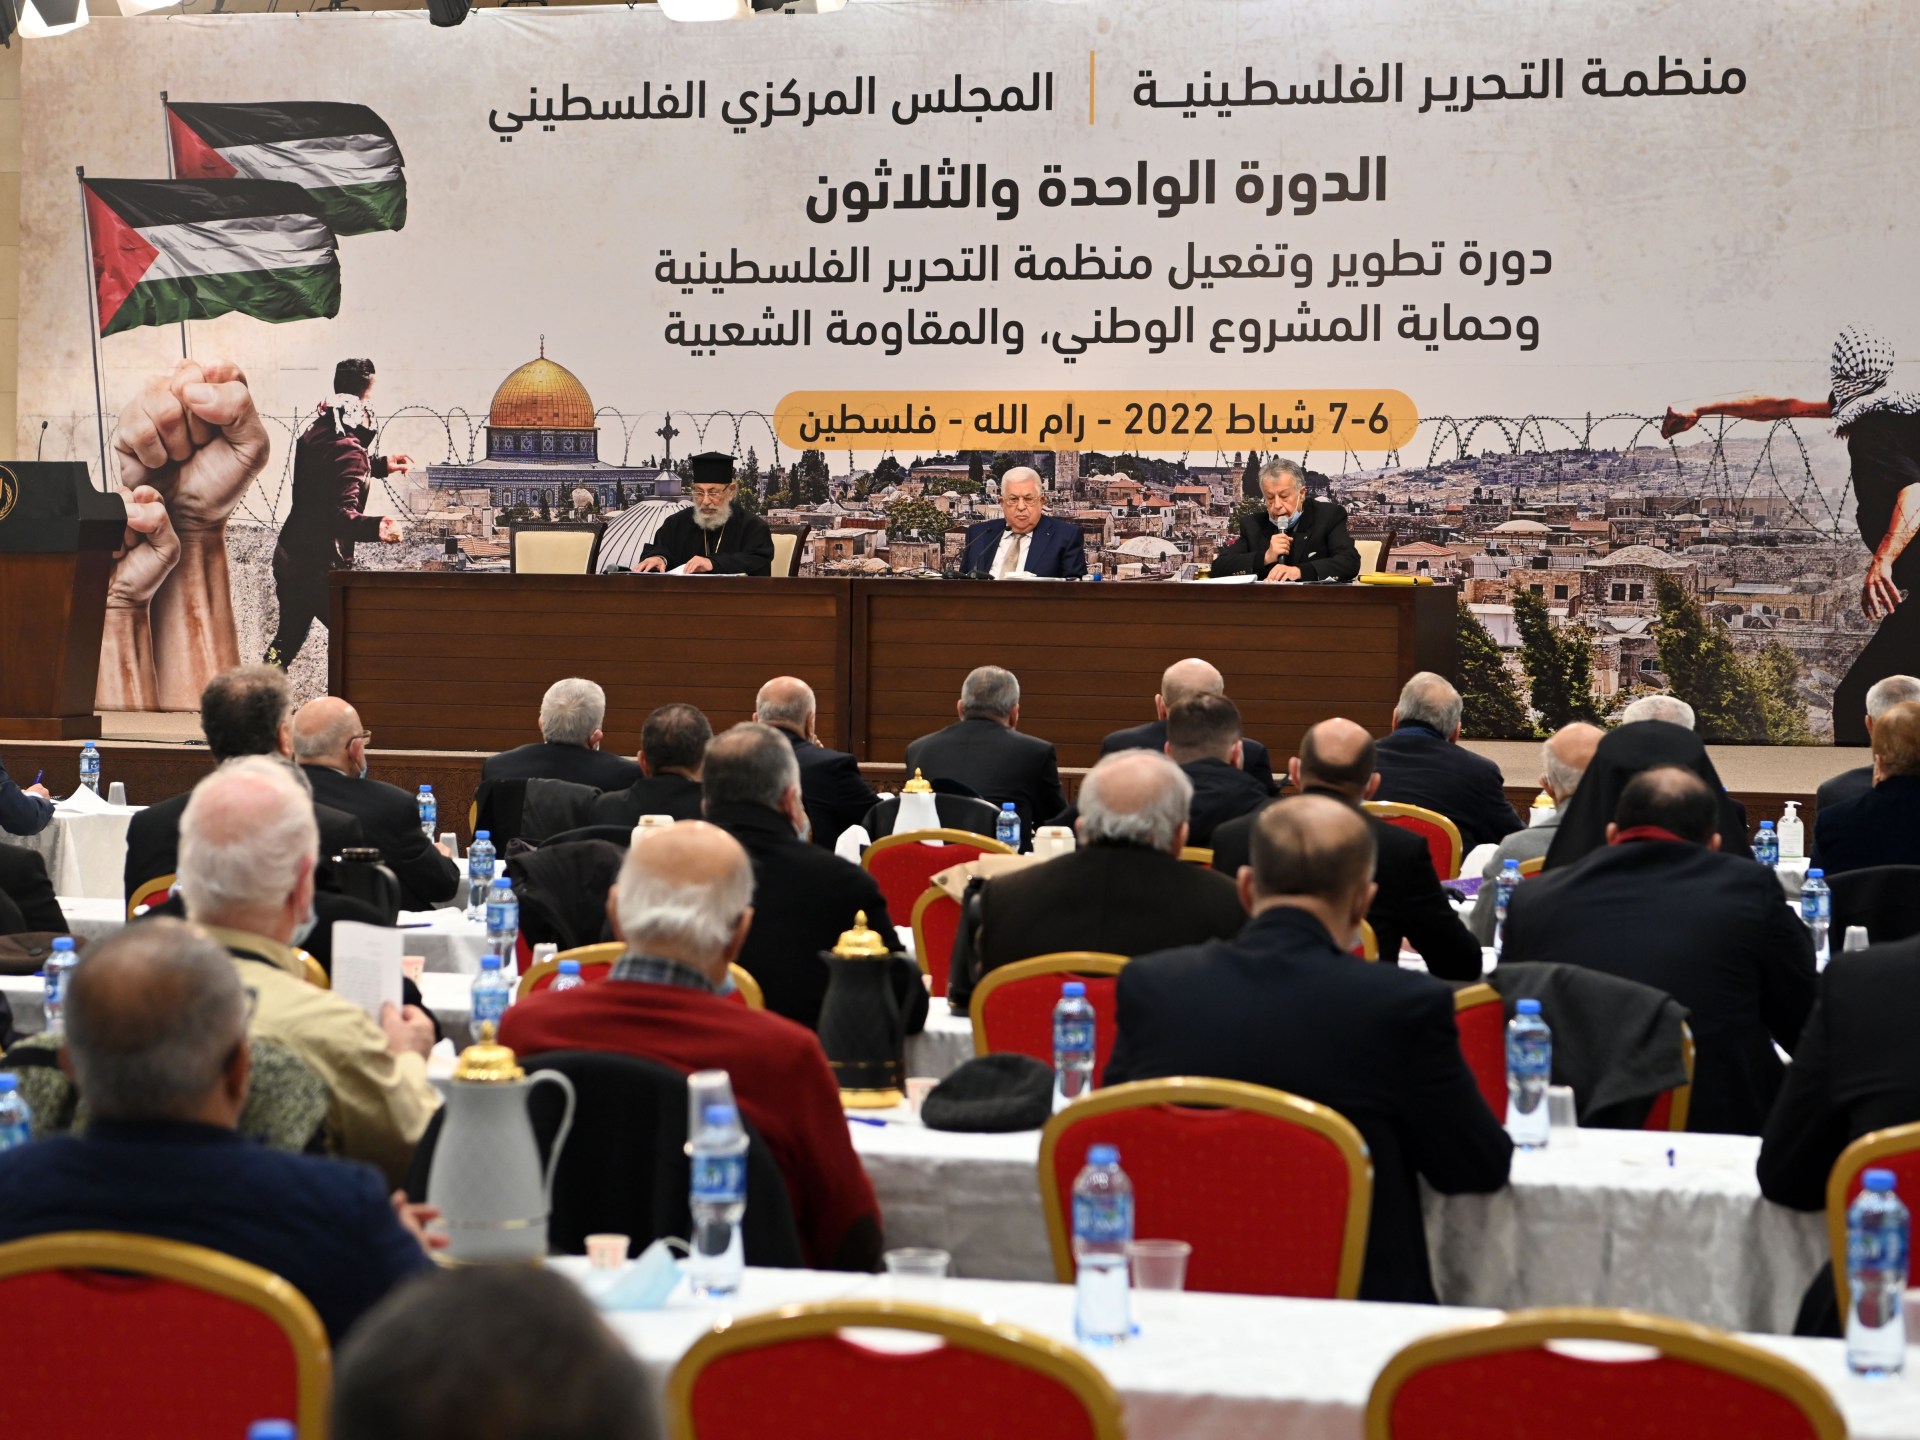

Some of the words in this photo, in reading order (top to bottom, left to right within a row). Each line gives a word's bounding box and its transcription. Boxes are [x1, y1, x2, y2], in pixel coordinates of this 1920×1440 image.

[891, 71, 1053, 126] المجلس
[1133, 62, 1403, 119] الفلسطينية
[1418, 57, 1564, 114] التحرير
[1581, 55, 1747, 98] منظمة
[488, 80, 706, 143] الفلسطيني
[721, 75, 876, 134] المركزي
[806, 157, 1019, 224] والثلاثون
[1038, 158, 1216, 219] الواحدة
[1235, 155, 1387, 217] الدورة
[654, 245, 870, 295] الفلسطينية
[882, 244, 999, 293] التحرير
[1014, 243, 1153, 281] منظمة
[1168, 241, 1313, 290] وتفعيل
[1327, 238, 1445, 288] تطوير
[1459, 240, 1552, 287] دورة
[664, 306, 811, 357] الشعبية
[826, 307, 1024, 356] والمقاومة
[1209, 300, 1381, 354] المشروع
[1397, 302, 1539, 352] وحماية
[799, 403, 936, 443] فلسطين
[974, 403, 1028, 434] الله
[1039, 403, 1085, 443] رام
[1124, 402, 1213, 435] 2022
[1225, 399, 1314, 434] شباط
